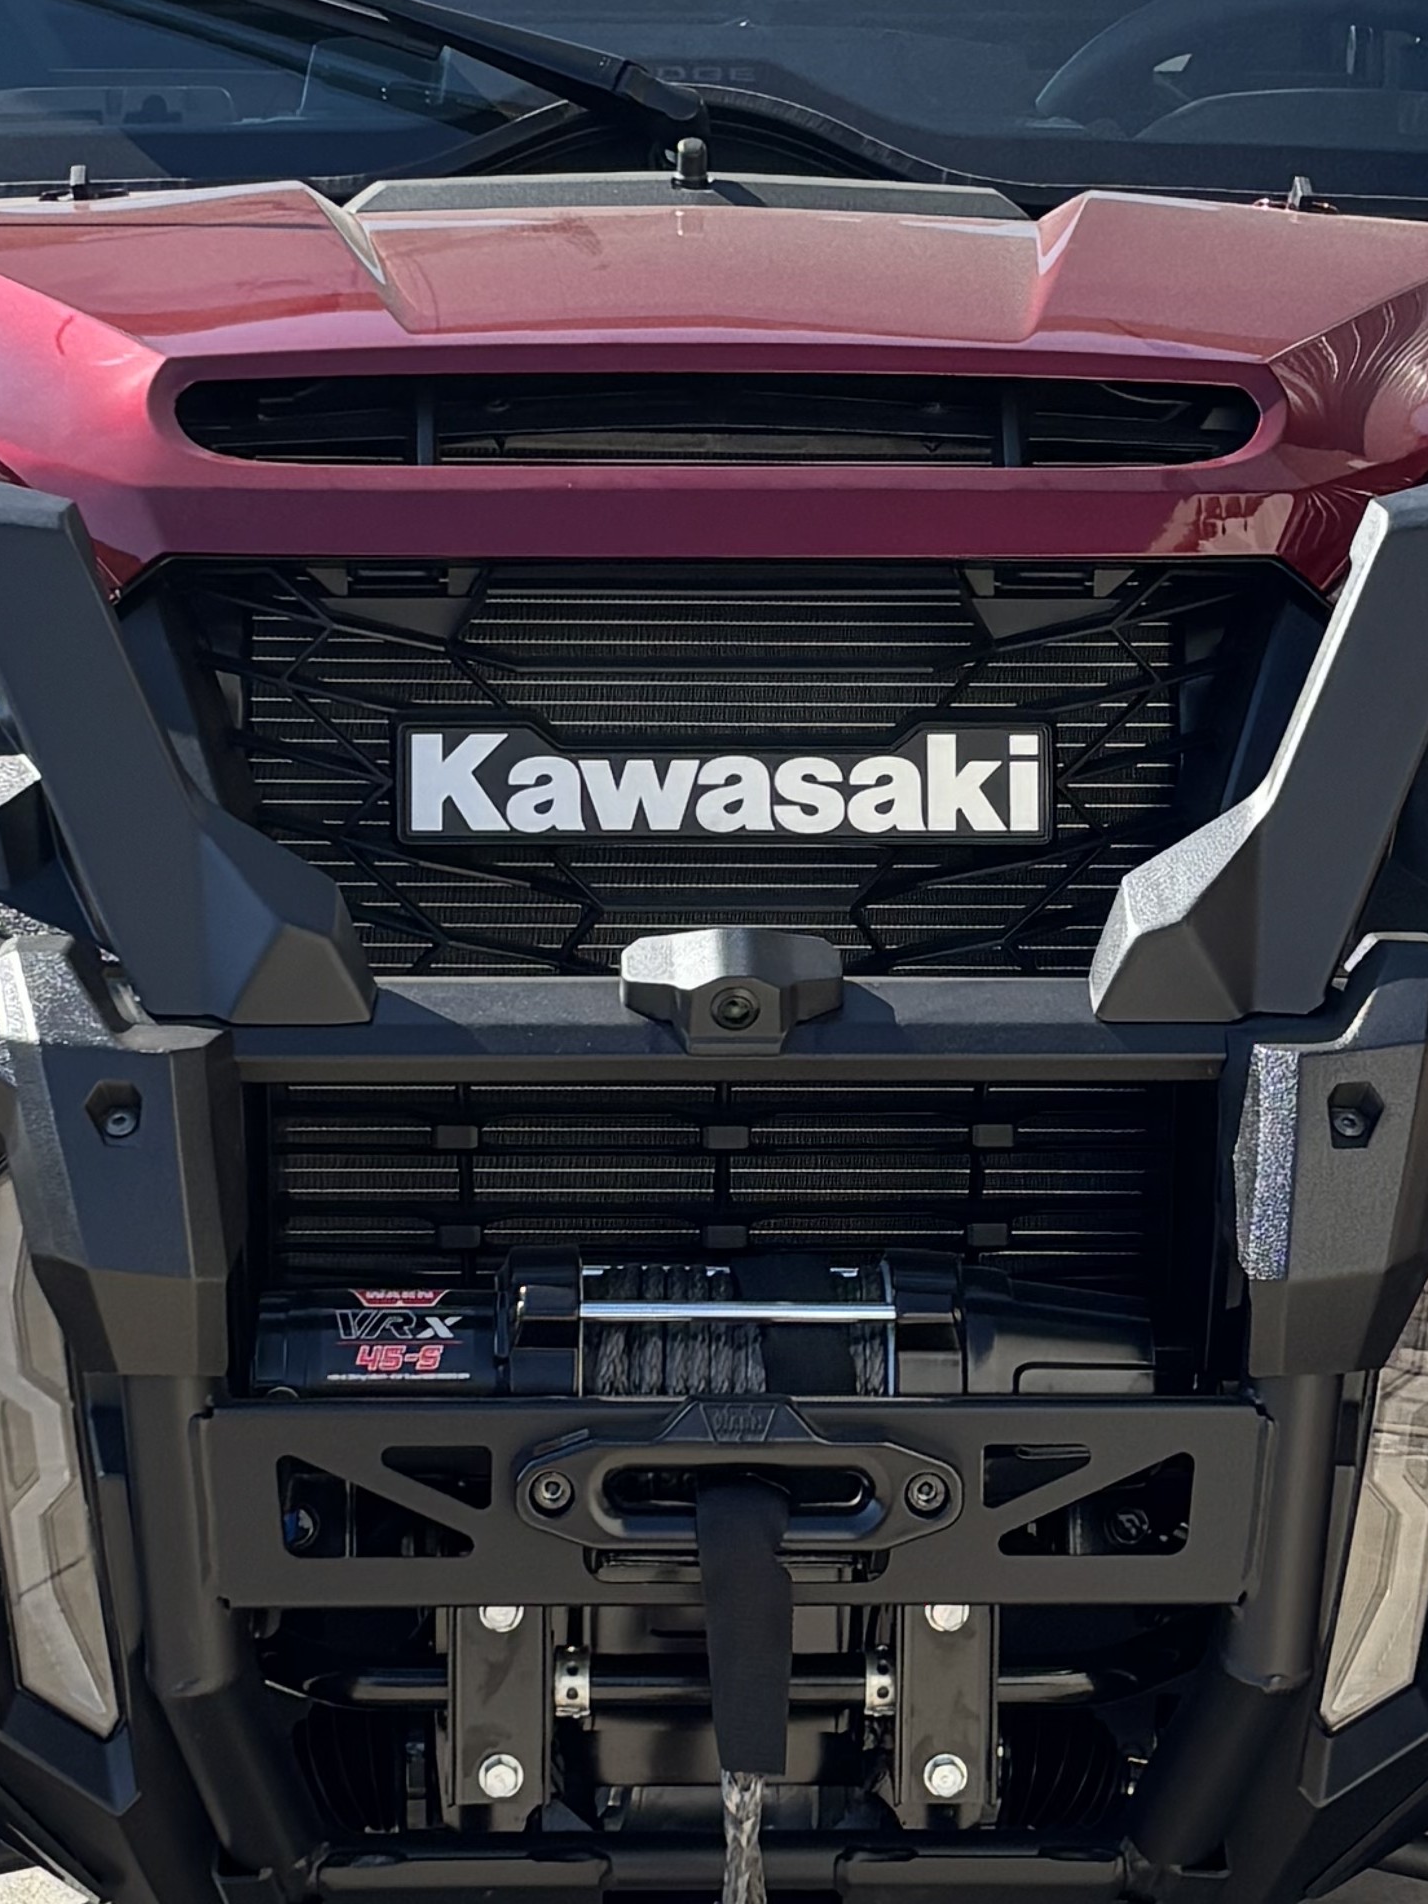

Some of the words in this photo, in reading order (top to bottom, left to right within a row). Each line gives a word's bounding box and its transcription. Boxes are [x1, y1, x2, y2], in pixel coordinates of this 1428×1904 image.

[655, 62, 757, 83] DGE
[411, 733, 1039, 834] Kawasaki
[335, 1310, 463, 1339] VRX
[356, 1345, 444, 1372] 45-S
